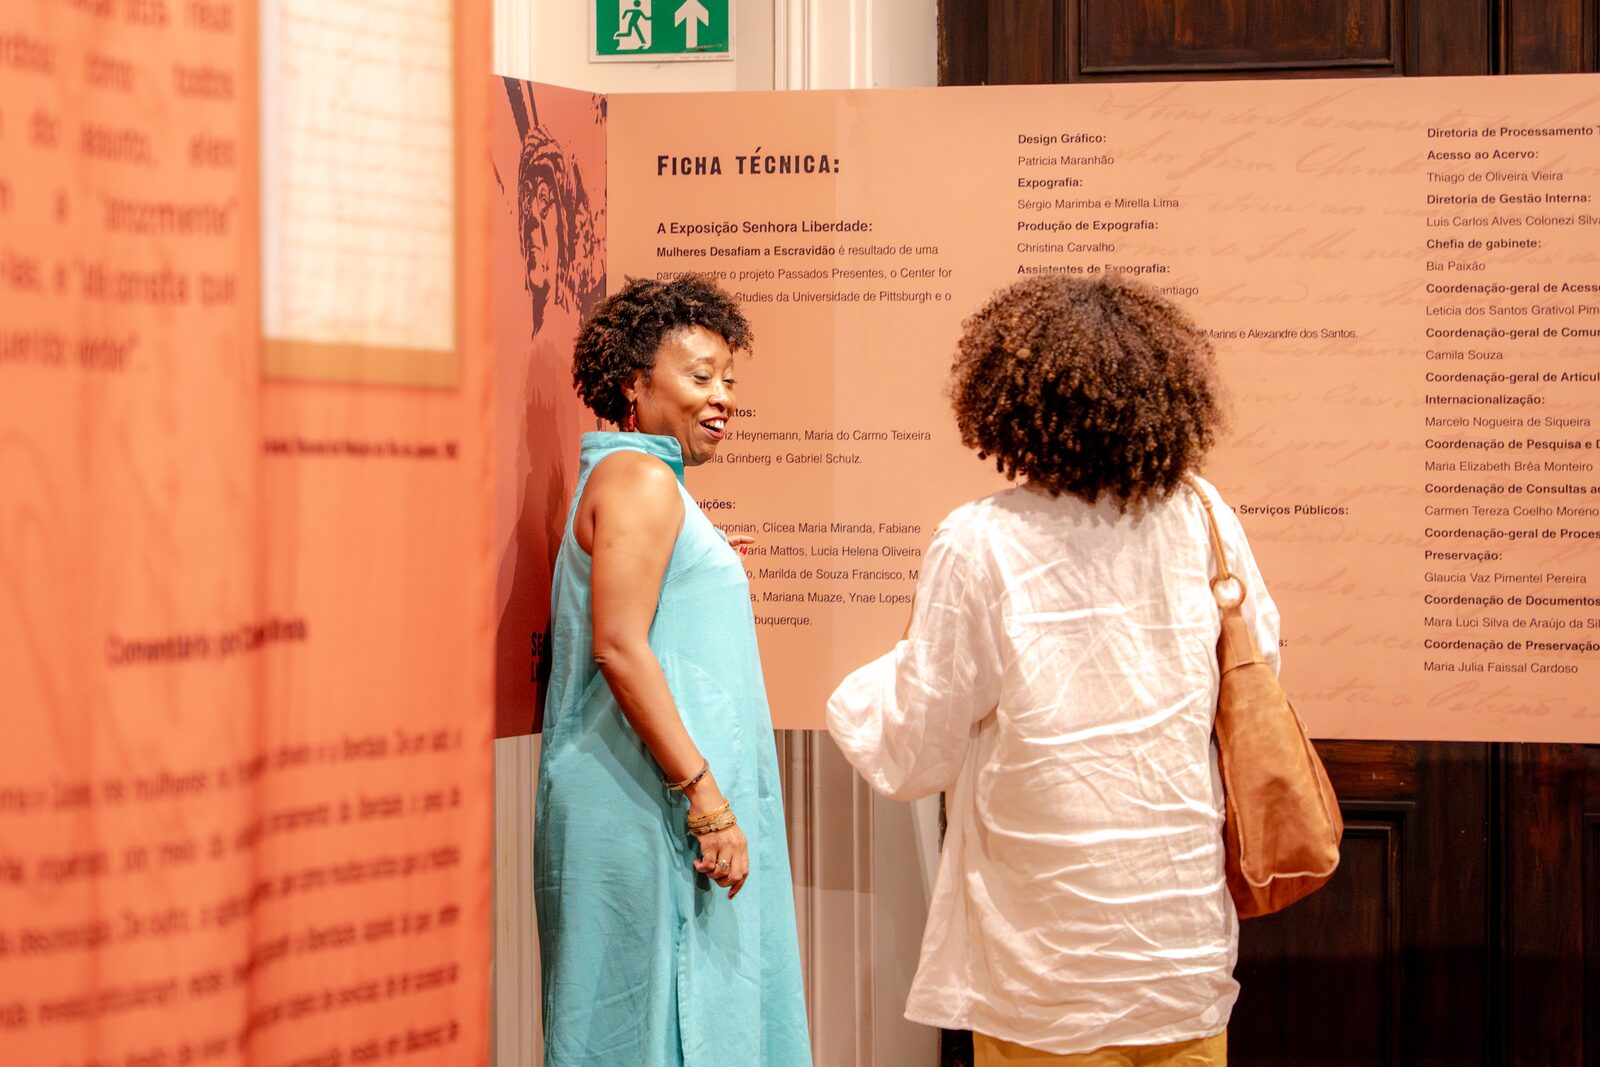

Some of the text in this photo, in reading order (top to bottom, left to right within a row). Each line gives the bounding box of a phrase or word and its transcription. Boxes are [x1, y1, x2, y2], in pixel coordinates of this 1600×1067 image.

[1428, 126, 1593, 138] Diretoria de Processamento
[1019, 133, 1106, 146] Design Gráfico:
[1018, 155, 1114, 166] Patricia Maranhão
[1427, 150, 1471, 160] Acesso
[1493, 150, 1538, 159] Acervo:
[658, 147, 839, 176] FICHA TÉCNICA:
[1018, 177, 1082, 189] Expografia:
[1427, 171, 1563, 184] Thiago de Oliveira Vieira
[1018, 198, 1179, 211] Sérgio Marimba Mirella Lima
[1427, 193, 1591, 204] Diretoria de Gestão Interna:
[1018, 220, 1158, 232] Produção de Expografia:
[1427, 216, 1574, 227] Luis Carlos Alves Colonezi
[671, 220, 872, 236] Exposição Senhora Liberdade:
[657, 247, 706, 257] Mulheres
[710, 246, 760, 256] Desafiam
[774, 245, 835, 256] Escravidão
[849, 245, 896, 255] resultado
[899, 245, 912, 254] de
[1017, 242, 1115, 253] Christina Carvalho
[1427, 239, 1541, 251] Chefia de gabinete:
[1017, 265, 1083, 274] Assistentes
[1087, 264, 1100, 273] de
[1427, 261, 1485, 271] Bia Paixão
[740, 267, 952, 282] projeto Passados Presentes, Center for
[1426, 283, 1557, 295] Coordenação-geral de
[735, 291, 931, 303] Studies da Universidade de Pittsburgh
[1426, 305, 1599, 316] Leticia dos Santos Grativol Pim
[1247, 328, 1297, 339] Alexandre
[1299, 328, 1318, 339] dos
[1321, 328, 1359, 339] Santos.
[1426, 328, 1557, 340] Coordenação-geral de
[1426, 350, 1464, 360] Camila
[1468, 350, 1503, 360] Souza
[1426, 372, 1539, 384] Coordenação-geral
[1543, 372, 1557, 382] de
[1426, 395, 1544, 406] Internacionalização:
[1426, 417, 1590, 429] Marcelo Nogueira de Siqueira
[737, 430, 801, 442] Heynemann,
[805, 430, 833, 440] Maria
[837, 430, 849, 440] do
[853, 430, 888, 440] Carmo
[891, 430, 931, 440] Teixeira
[1425, 439, 1581, 451] Coordenação de Pesquisa
[727, 453, 862, 466] Grinberg Gabriel Schulz.
[1425, 461, 1593, 471] Maria Elizabeth Brêa Monteiro
[1425, 483, 1587, 496] Coordenação de Consultas
[1240, 505, 1290, 517] Serviços
[1295, 505, 1348, 515] Públicos:
[1425, 505, 1599, 516] Carmen Tereza Coelho Moreno
[763, 522, 795, 533] Clícea
[799, 523, 827, 533] Maria
[831, 523, 875, 534] Miranda,
[879, 523, 920, 533] Fabiane
[1425, 528, 1538, 540] Coordenação-geral
[1542, 529, 1556, 538] de
[770, 545, 921, 557] Mattos, Lucia Helena Oliveira
[1425, 550, 1502, 563] Preservação:
[759, 569, 796, 579] Marilda
[800, 569, 812, 579] de
[816, 569, 848, 579] Souza
[852, 569, 905, 581] Francisco,
[1425, 572, 1586, 583] Glaucia Vaz Pimentel Pereira
[763, 592, 804, 602] Mariana
[808, 592, 845, 603] Muaze,
[849, 593, 875, 603] Ynae
[879, 593, 911, 605] Lopes
[1424, 594, 1503, 607] Coordenação
[1507, 596, 1522, 605] de
[754, 614, 812, 627] buquerque.
[1424, 617, 1452, 627] Mara
[1456, 617, 1478, 627] Luci
[1482, 617, 1509, 628] Silva
[1512, 618, 1527, 628] de
[1529, 618, 1565, 630] Araújo
[1569, 619, 1583, 628] da
[1424, 639, 1600, 653] Coordenação de Preservação
[1424, 661, 1578, 673] Maria Julia Faissal Cardoso
